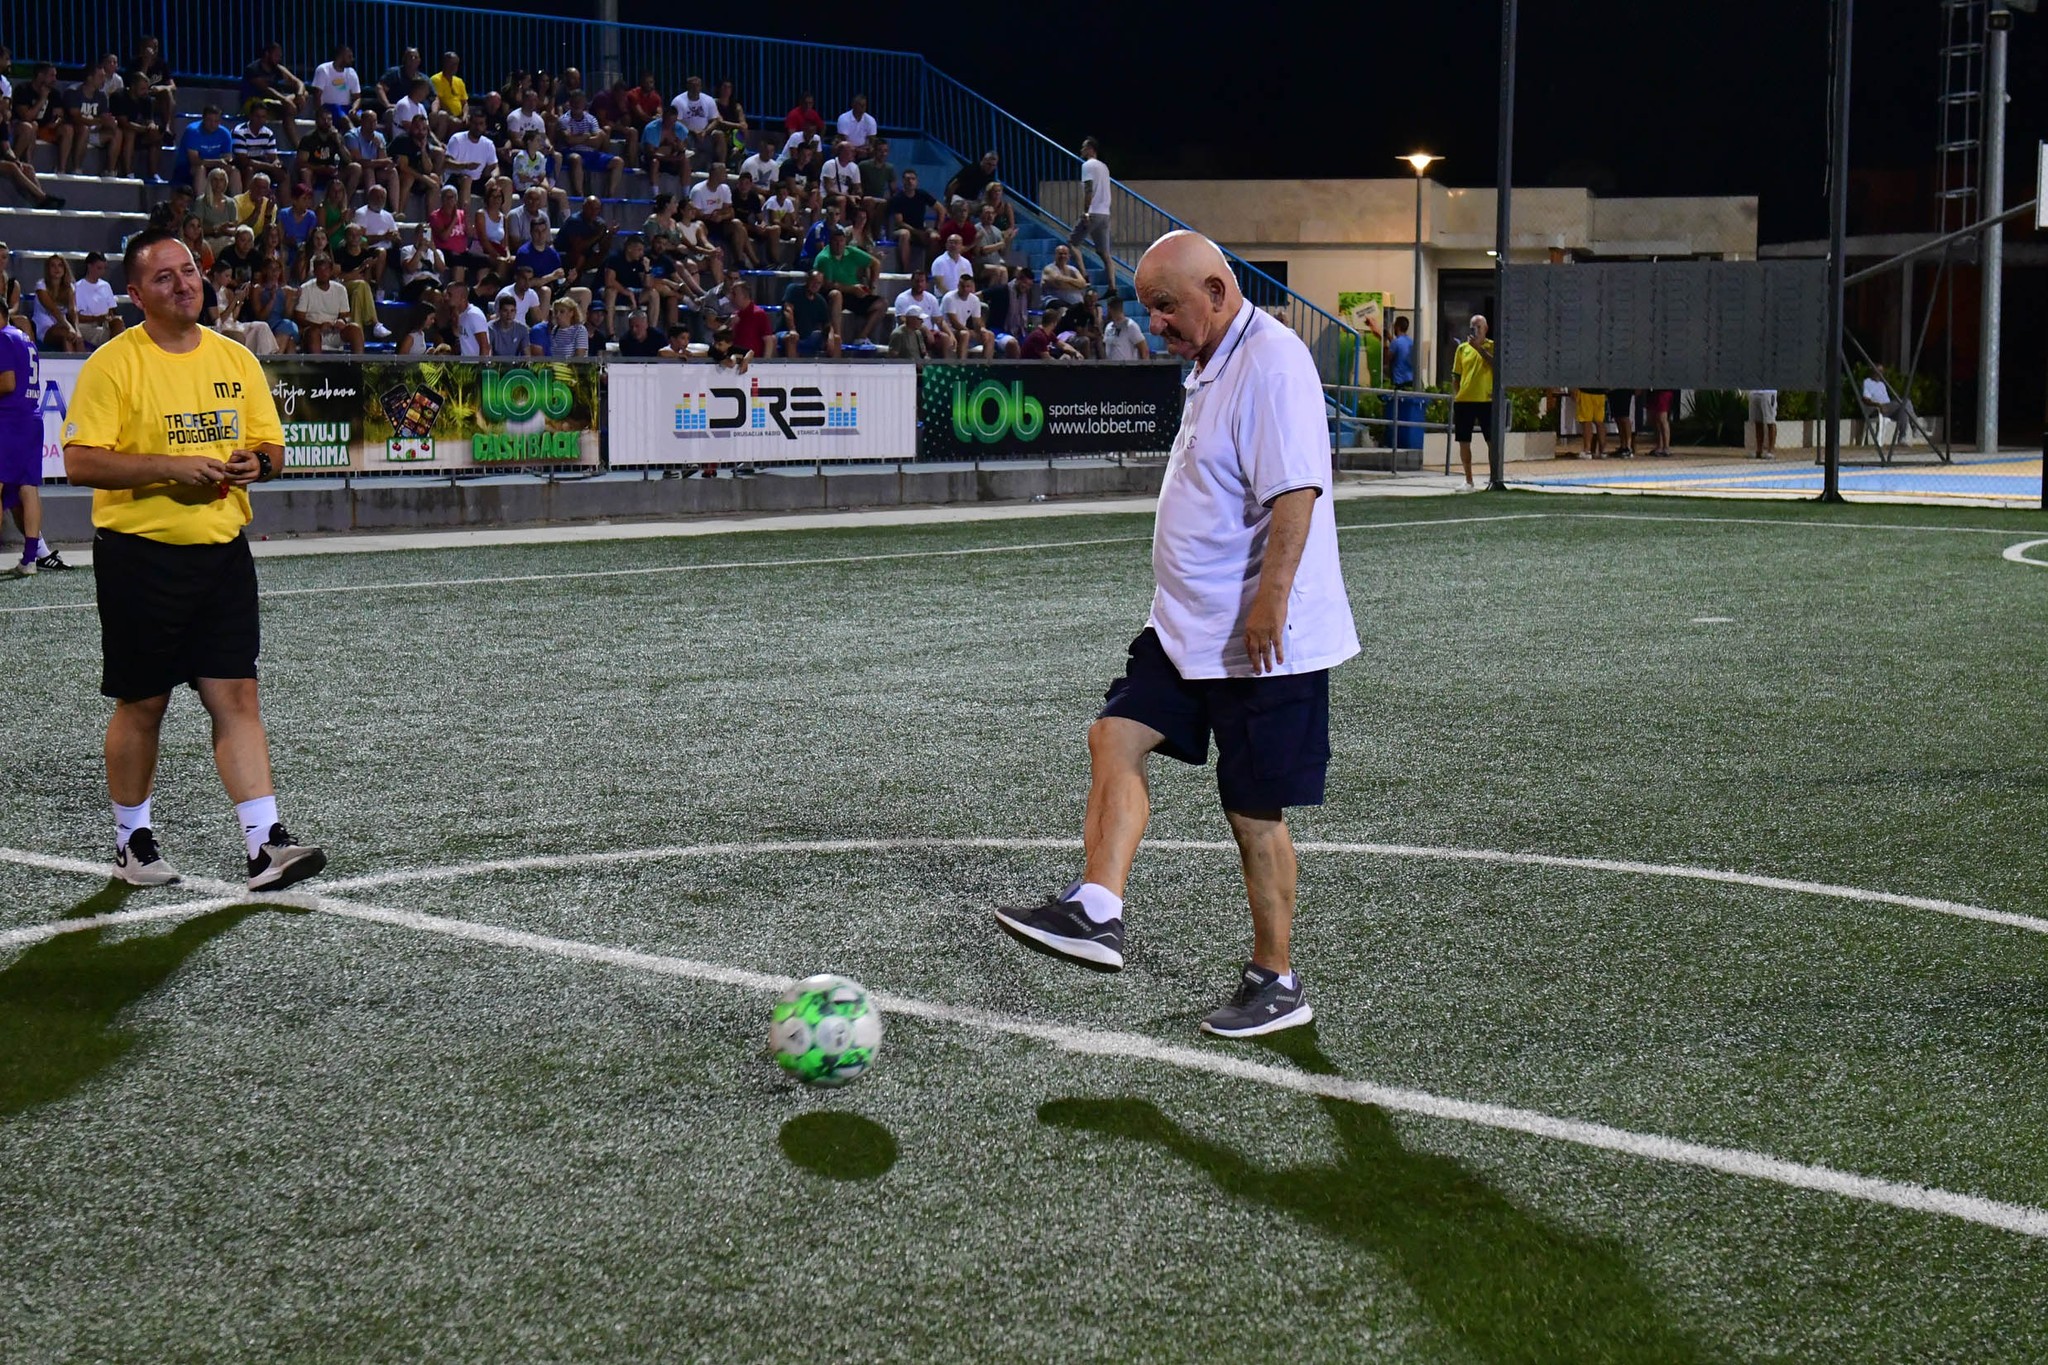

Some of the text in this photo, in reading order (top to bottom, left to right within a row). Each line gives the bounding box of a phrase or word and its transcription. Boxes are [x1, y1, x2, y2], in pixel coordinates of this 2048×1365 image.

[213, 382, 244, 399] M.P.
[310, 377, 356, 400] zabava
[1049, 400, 1157, 417] sportske kladionice
[164, 411, 219, 429] TROFEJ
[1049, 418, 1157, 435] www.lobbet.me
[340, 423, 350, 442] U
[471, 430, 582, 461] CASHBACK
